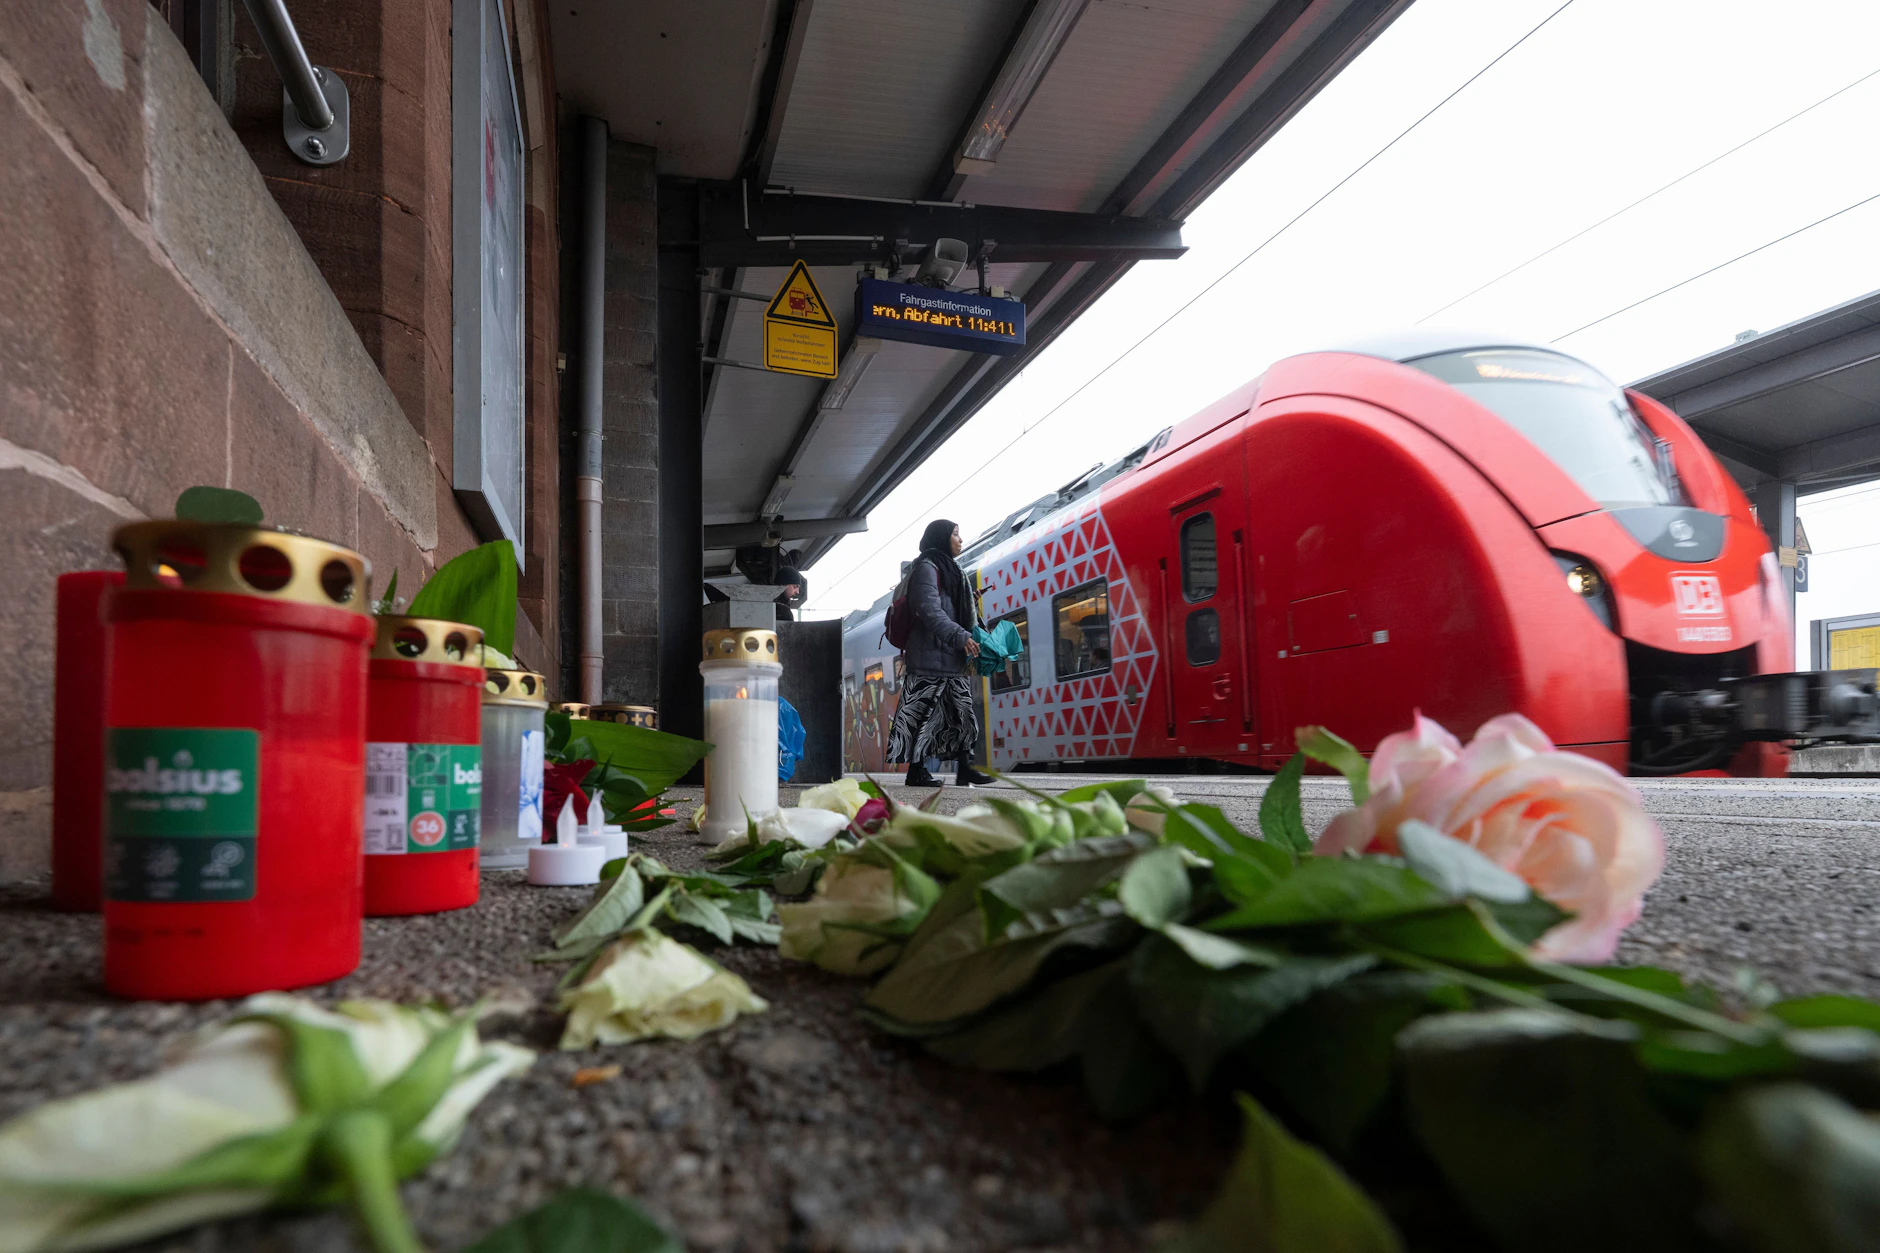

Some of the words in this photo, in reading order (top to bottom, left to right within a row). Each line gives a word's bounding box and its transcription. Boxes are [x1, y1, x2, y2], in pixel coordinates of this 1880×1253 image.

[900, 293, 991, 316] Fahrgastinformation
[904, 307, 962, 327] Abfahrt
[968, 317, 1004, 333] 11:41
[1796, 557, 1806, 584] 3
[1670, 574, 1724, 616] DB
[416, 820, 439, 834] 36
